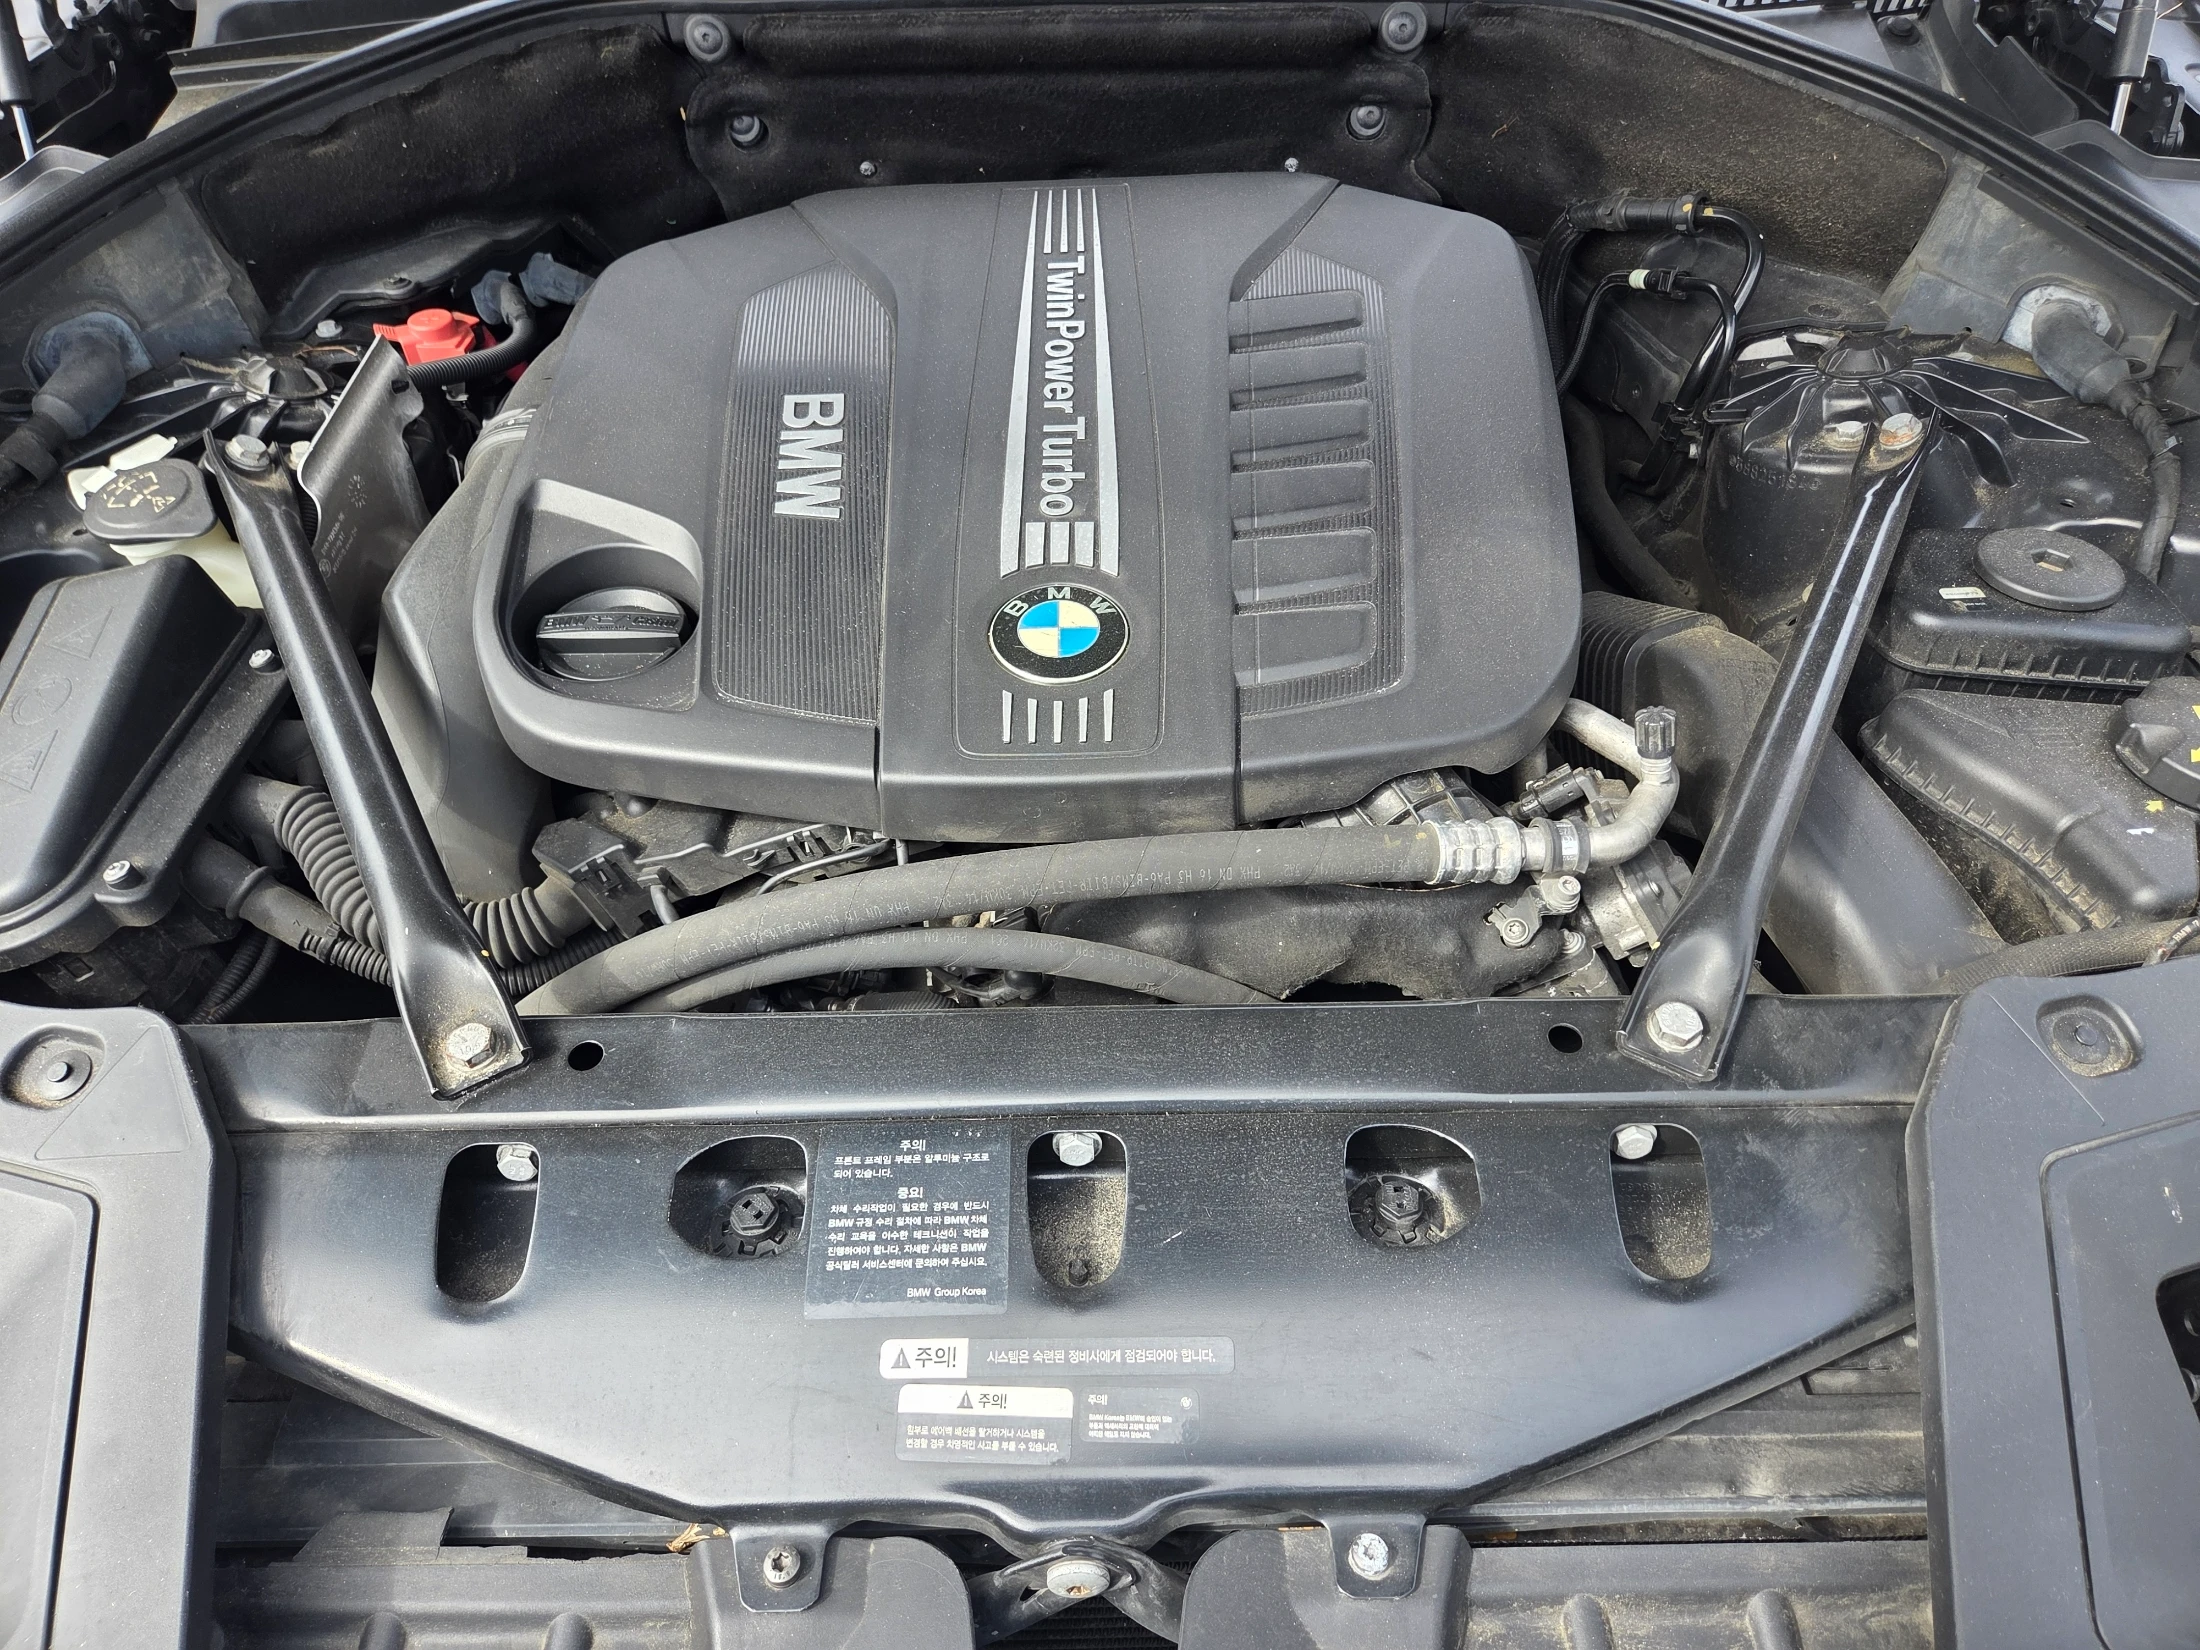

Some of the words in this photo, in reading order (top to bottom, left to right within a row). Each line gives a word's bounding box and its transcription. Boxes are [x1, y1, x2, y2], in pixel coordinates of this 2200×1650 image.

[1044, 255, 1086, 412] TwinPower
[774, 393, 845, 519] BMW
[1039, 417, 1086, 516] Turbo
[1003, 587, 1116, 617] BMW
[963, 1153, 990, 1162] 구조로
[855, 1168, 893, 1178] 있습니다.
[828, 1218, 854, 1228] BMW
[876, 1216, 893, 1226] 수리
[944, 1215, 969, 1225] BMW
[961, 1243, 987, 1252] BMW
[907, 1288, 931, 1297] BMW
[934, 1287, 960, 1298] Group
[962, 1287, 987, 1296] Korea
[915, 1346, 957, 1368] 주의!
[987, 1350, 1029, 1364] 시스템은
[1032, 1350, 1065, 1363] 숙련된
[1068, 1349, 1121, 1363] 정비사에게
[1125, 1349, 1177, 1363] 점검되어야
[1181, 1348, 1216, 1362] 합니다.
[978, 1393, 1007, 1409] 주의!
[1018, 1441, 1026, 1451] 수
